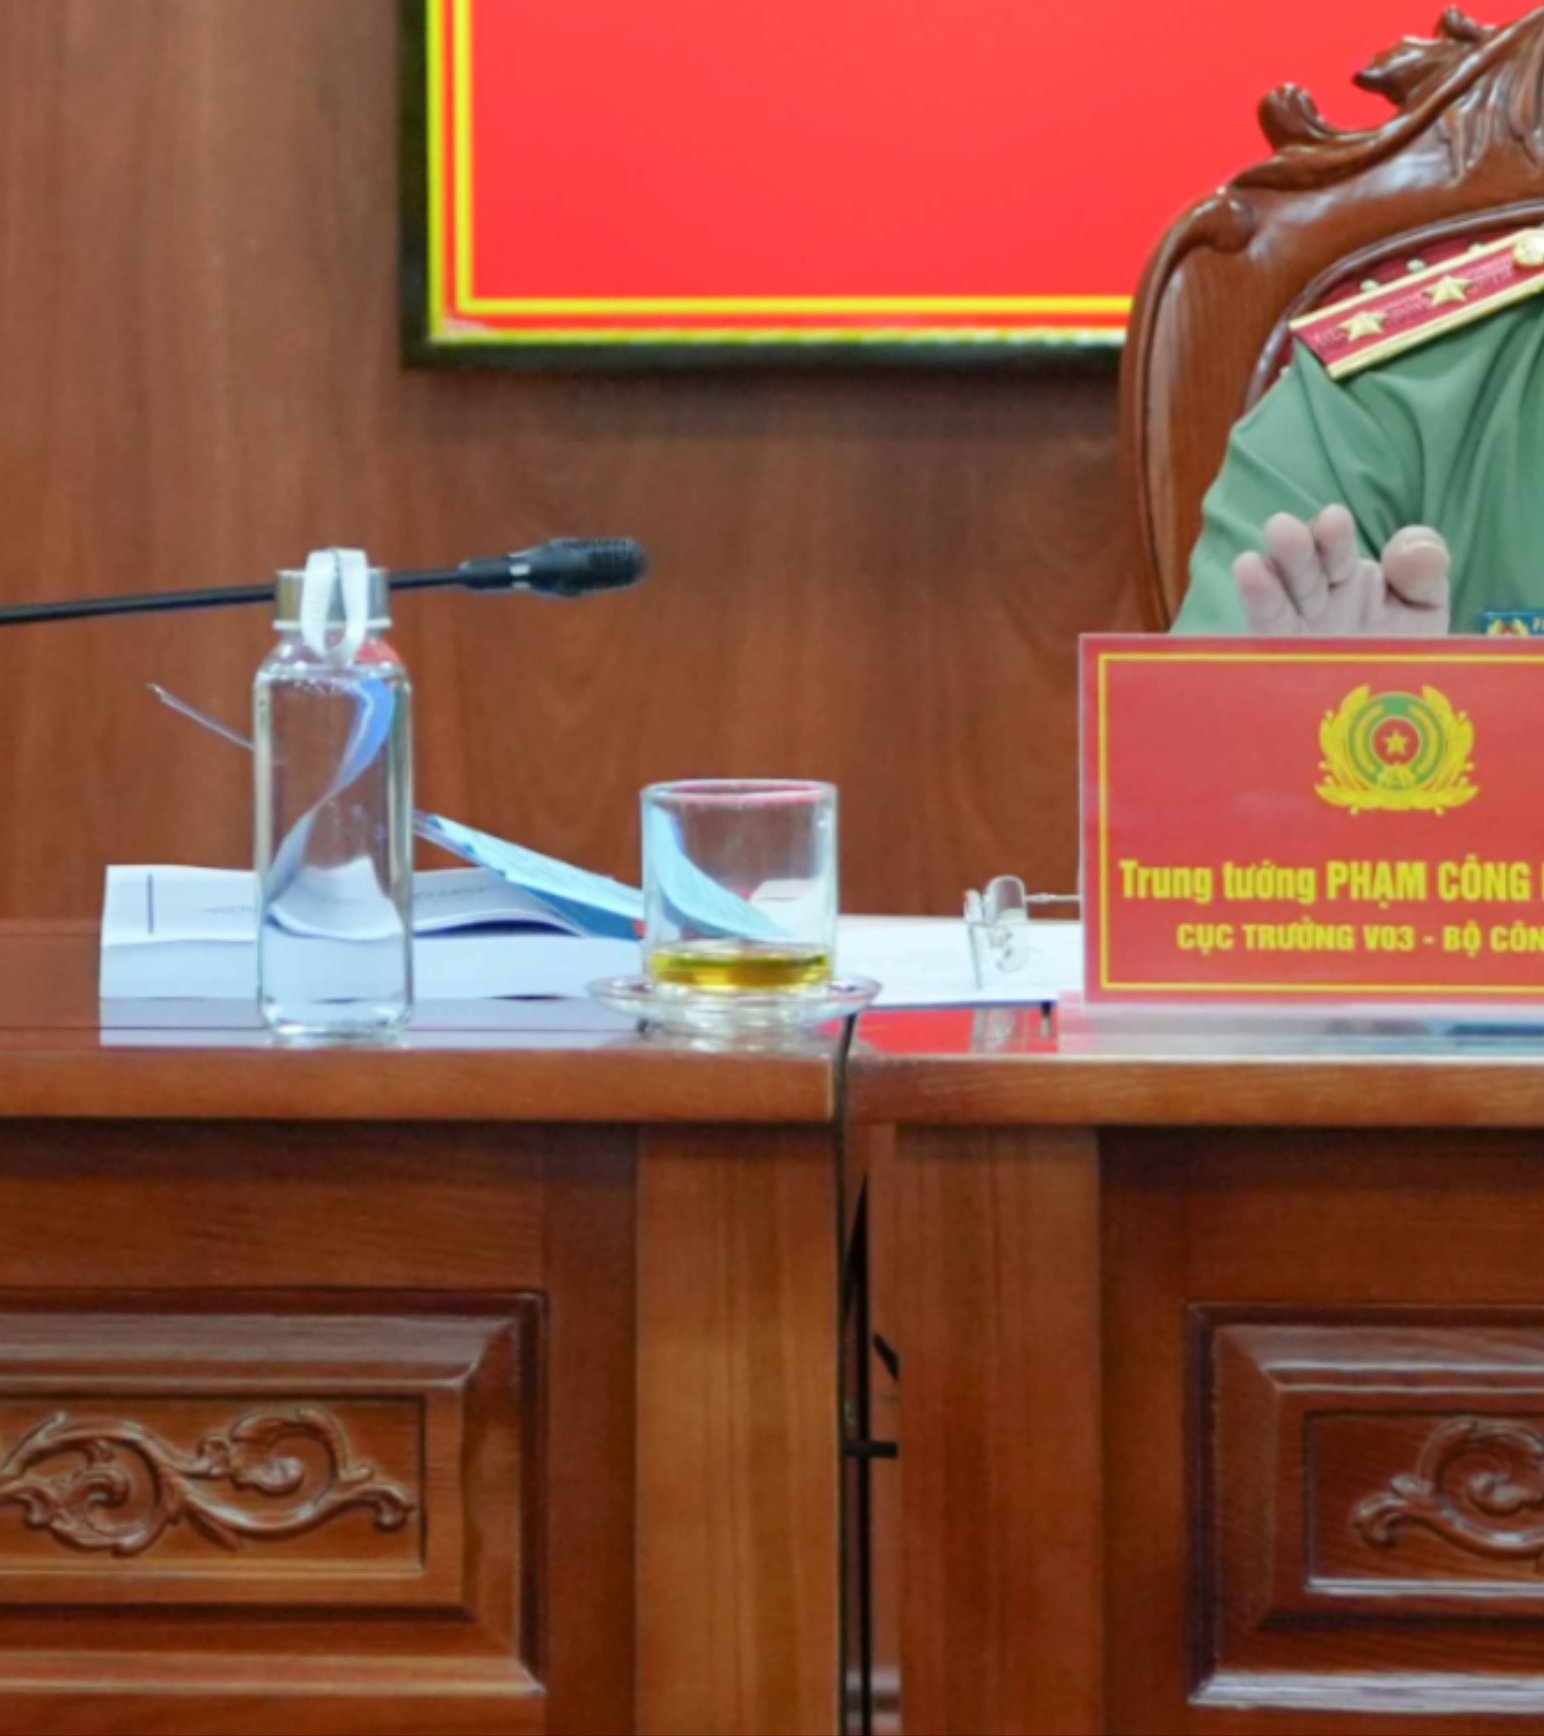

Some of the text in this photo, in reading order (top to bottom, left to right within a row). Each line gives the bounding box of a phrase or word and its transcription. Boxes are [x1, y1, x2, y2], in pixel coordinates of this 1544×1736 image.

[1119, 859, 1213, 904] Trung
[1223, 860, 1317, 905] tướng
[1327, 861, 1427, 909] PHẠM
[1438, 854, 1532, 902] CÔNG
[1177, 923, 1234, 955] CỤC
[1242, 916, 1355, 951] TRƯỞNG
[1363, 925, 1415, 951] V03
[1443, 921, 1482, 957] BỘ
